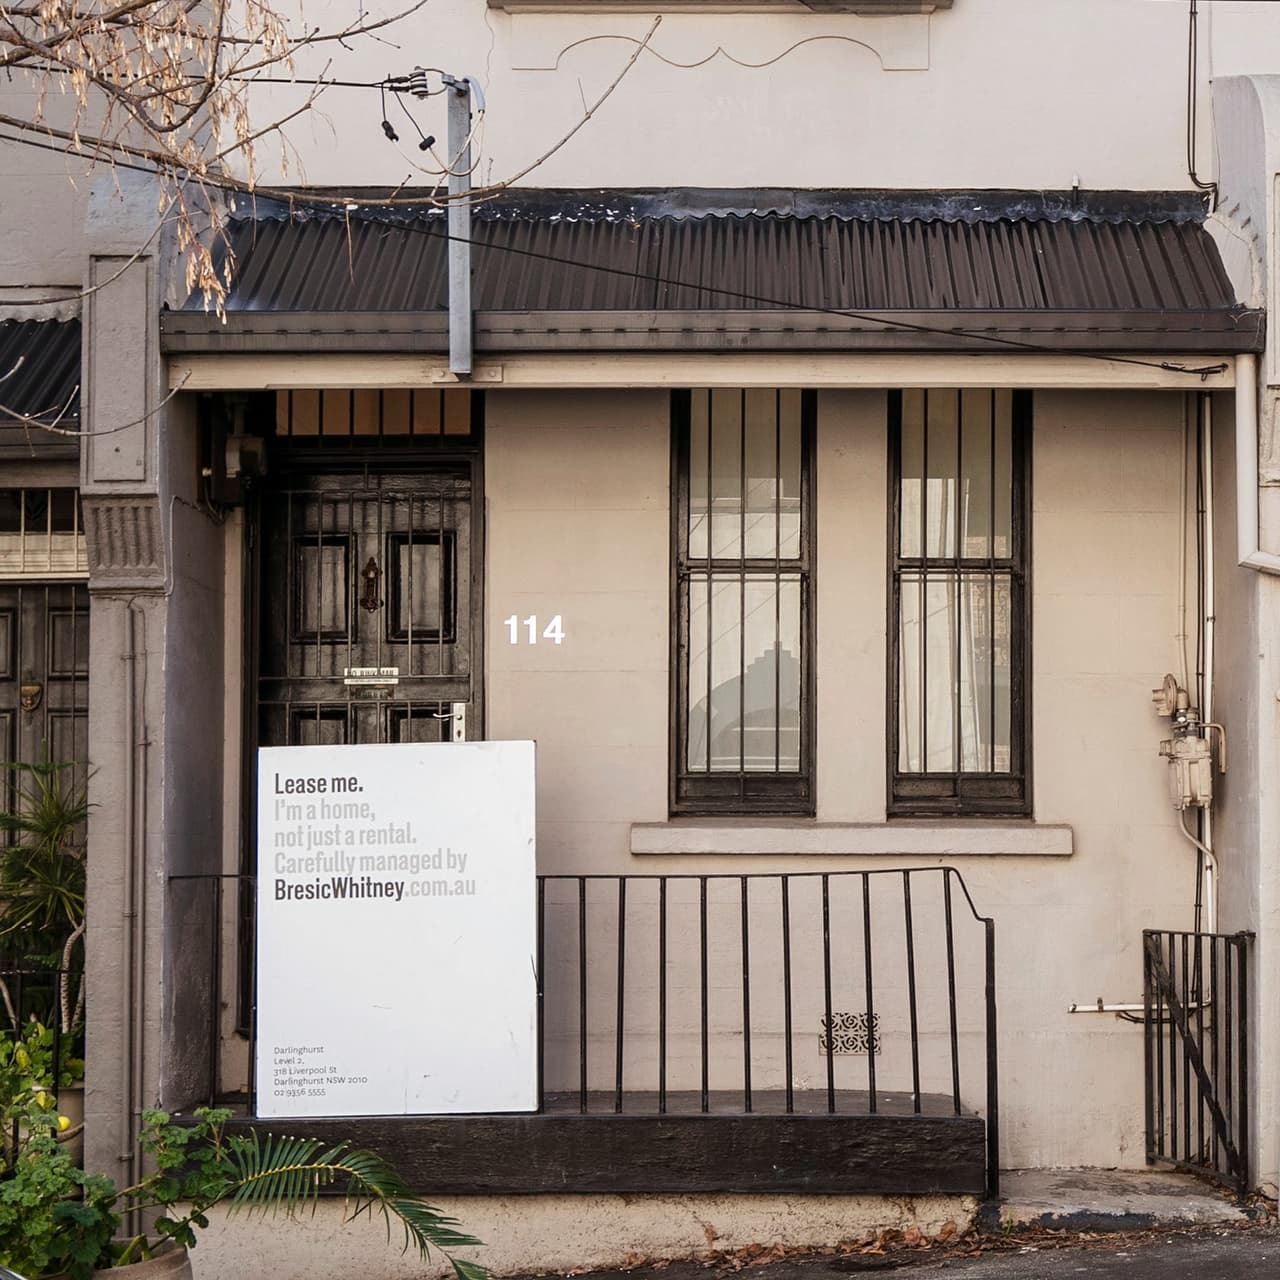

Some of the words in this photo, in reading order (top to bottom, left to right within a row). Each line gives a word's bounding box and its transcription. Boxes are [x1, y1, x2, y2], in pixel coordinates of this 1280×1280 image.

[503, 614, 566, 645] 114
[275, 773, 327, 794] Lease
[331, 776, 364, 793] me.
[306, 804, 316, 820] a
[321, 798, 376, 821] home,
[275, 825, 304, 847] not
[307, 823, 342, 851] just
[345, 829, 355, 845] a
[359, 822, 417, 845] rental.
[275, 851, 355, 876] Carefully
[360, 848, 442, 875] managed
[447, 848, 468, 873] by
[275, 876, 476, 902] BresicWhitney.com.au
[274, 1046, 324, 1055] Darlinghurst
[274, 1057, 295, 1065] Level
[273, 1068, 287, 1076] 318
[289, 1066, 327, 1077] Liverpool
[329, 1066, 337, 1074] St
[274, 1078, 324, 1087] Darlinghurst
[308, 1088, 326, 1097] 5555
